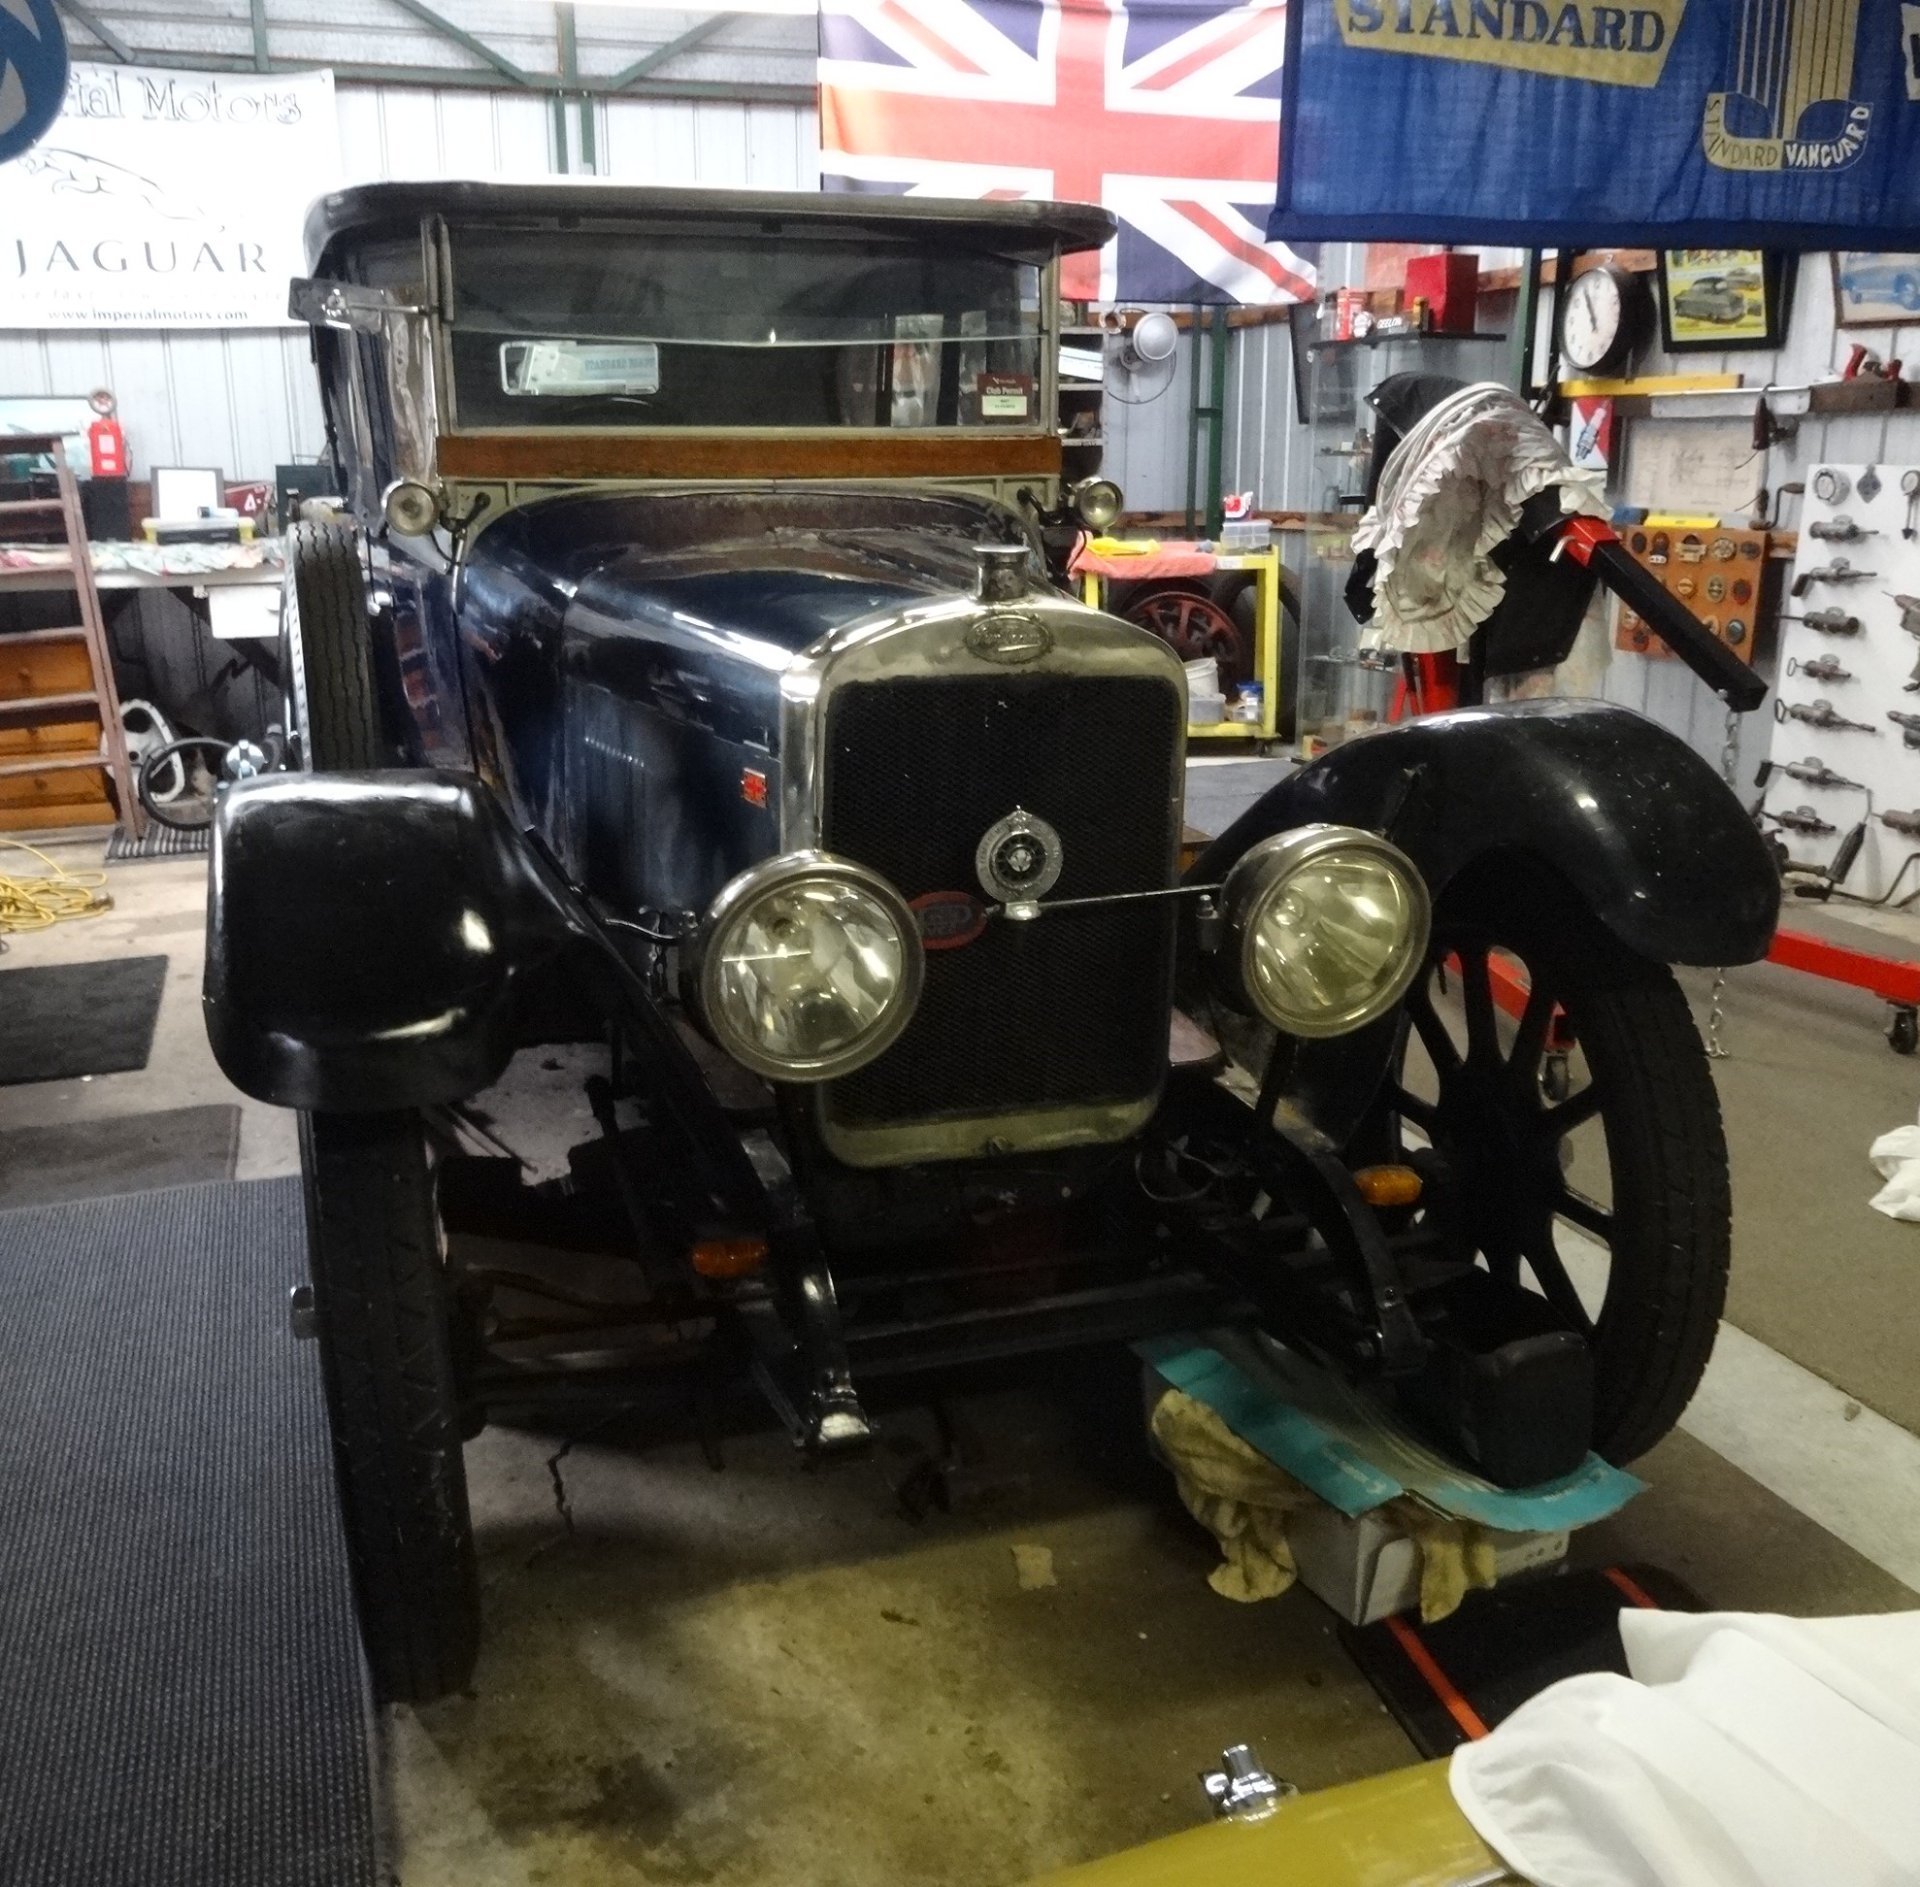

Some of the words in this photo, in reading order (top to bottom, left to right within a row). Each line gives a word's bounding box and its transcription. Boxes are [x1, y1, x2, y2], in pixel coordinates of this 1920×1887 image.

[1348, 0, 1666, 54] STANDARD
[137, 76, 301, 125] Motors
[1704, 98, 1779, 168] STANDARD
[1785, 105, 1870, 169] VANGUARD
[15, 238, 267, 277] JAGUAR
